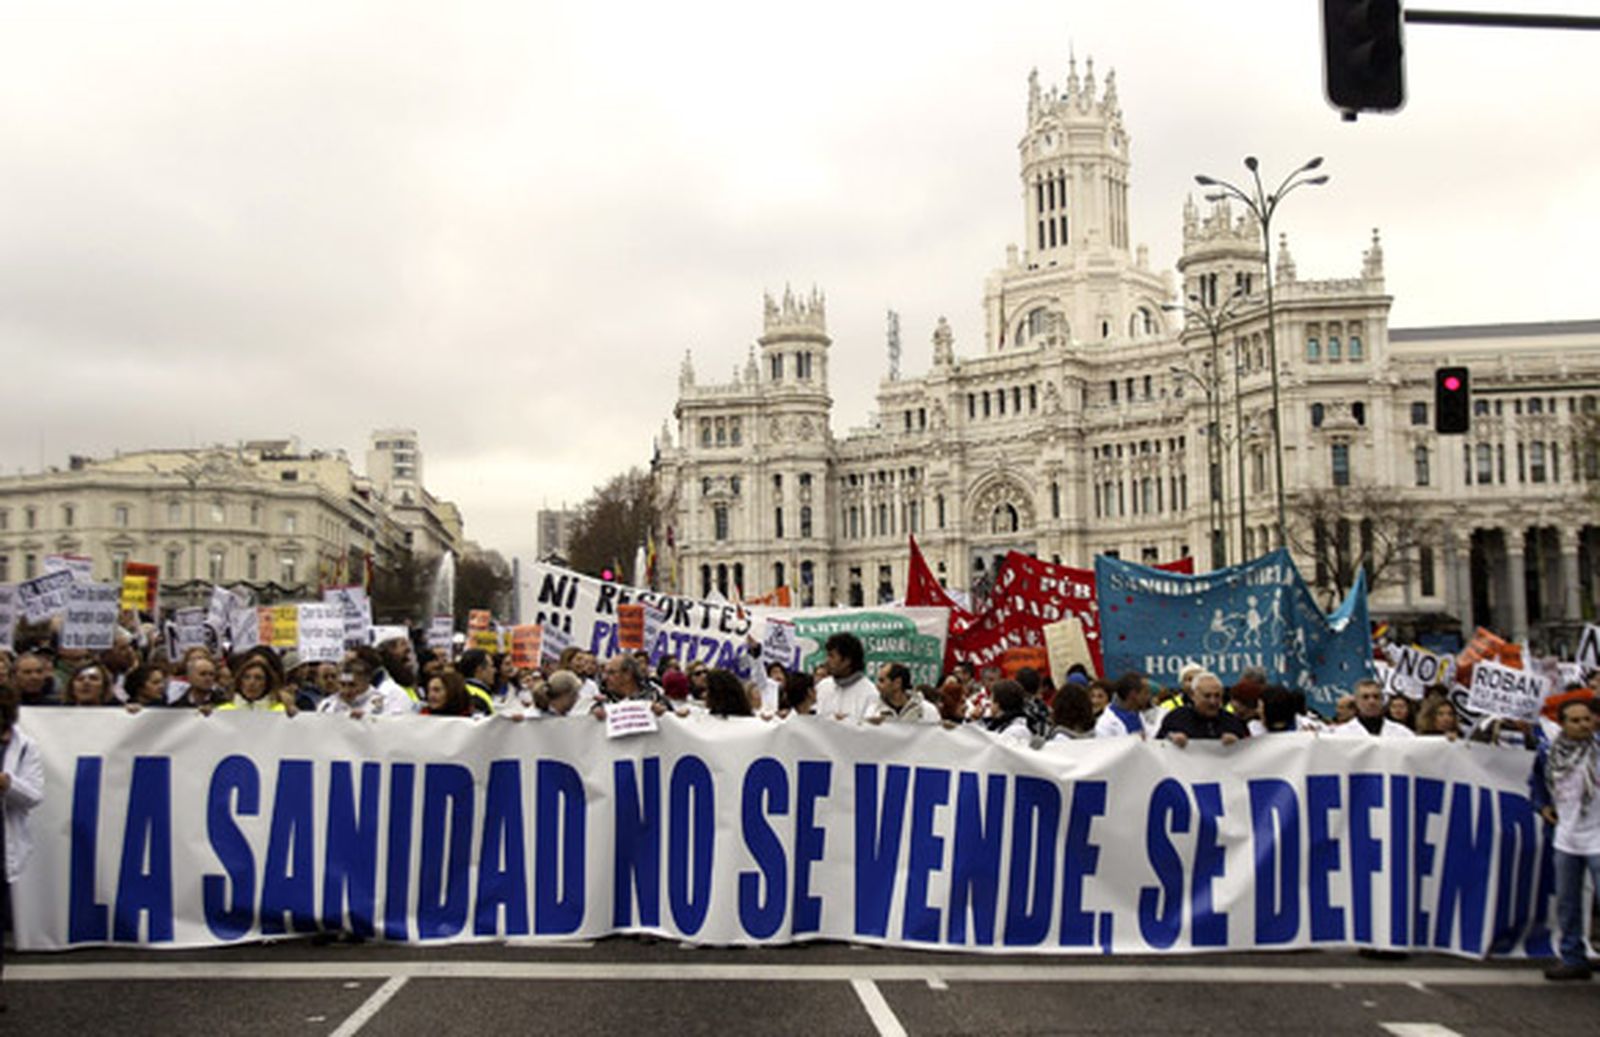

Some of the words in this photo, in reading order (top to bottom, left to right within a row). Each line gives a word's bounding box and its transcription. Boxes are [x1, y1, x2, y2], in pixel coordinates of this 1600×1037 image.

[1145, 653, 1263, 674] HOPITAL
[1396, 649, 1438, 682] NO
[1475, 666, 1544, 699] ROBAN
[68, 755, 174, 943] LA
[203, 754, 587, 943] SANIDAD
[613, 754, 715, 936] NO
[738, 757, 833, 940] SE
[854, 763, 1113, 955] VENDE,
[1138, 777, 1229, 950] SE
[1246, 773, 1556, 960] DEFIEND
